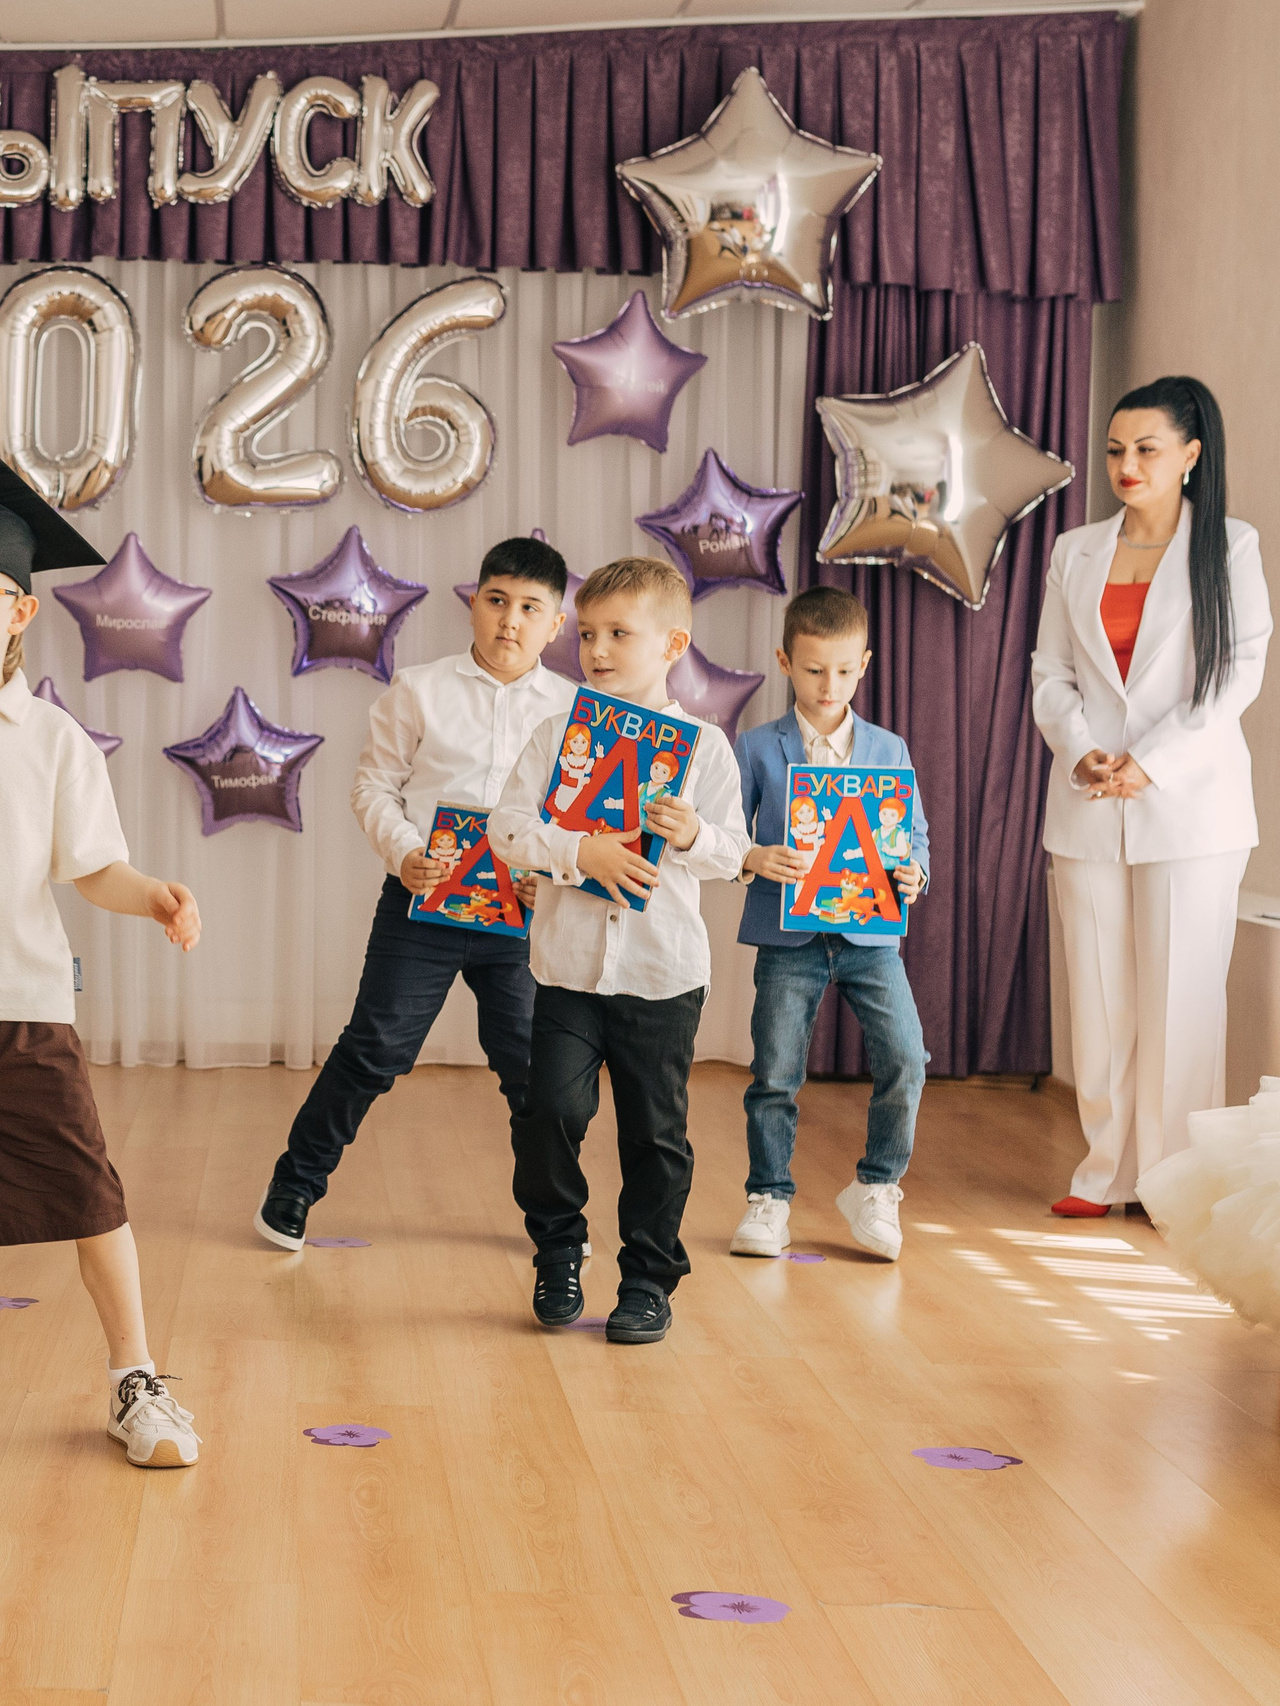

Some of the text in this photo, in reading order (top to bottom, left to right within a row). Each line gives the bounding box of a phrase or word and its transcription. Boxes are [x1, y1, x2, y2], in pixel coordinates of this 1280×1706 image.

[698, 533, 751, 555] Роман
[572, 695, 691, 758] БУКВАРЬ
[793, 772, 913, 799] БУКВАРЬ
